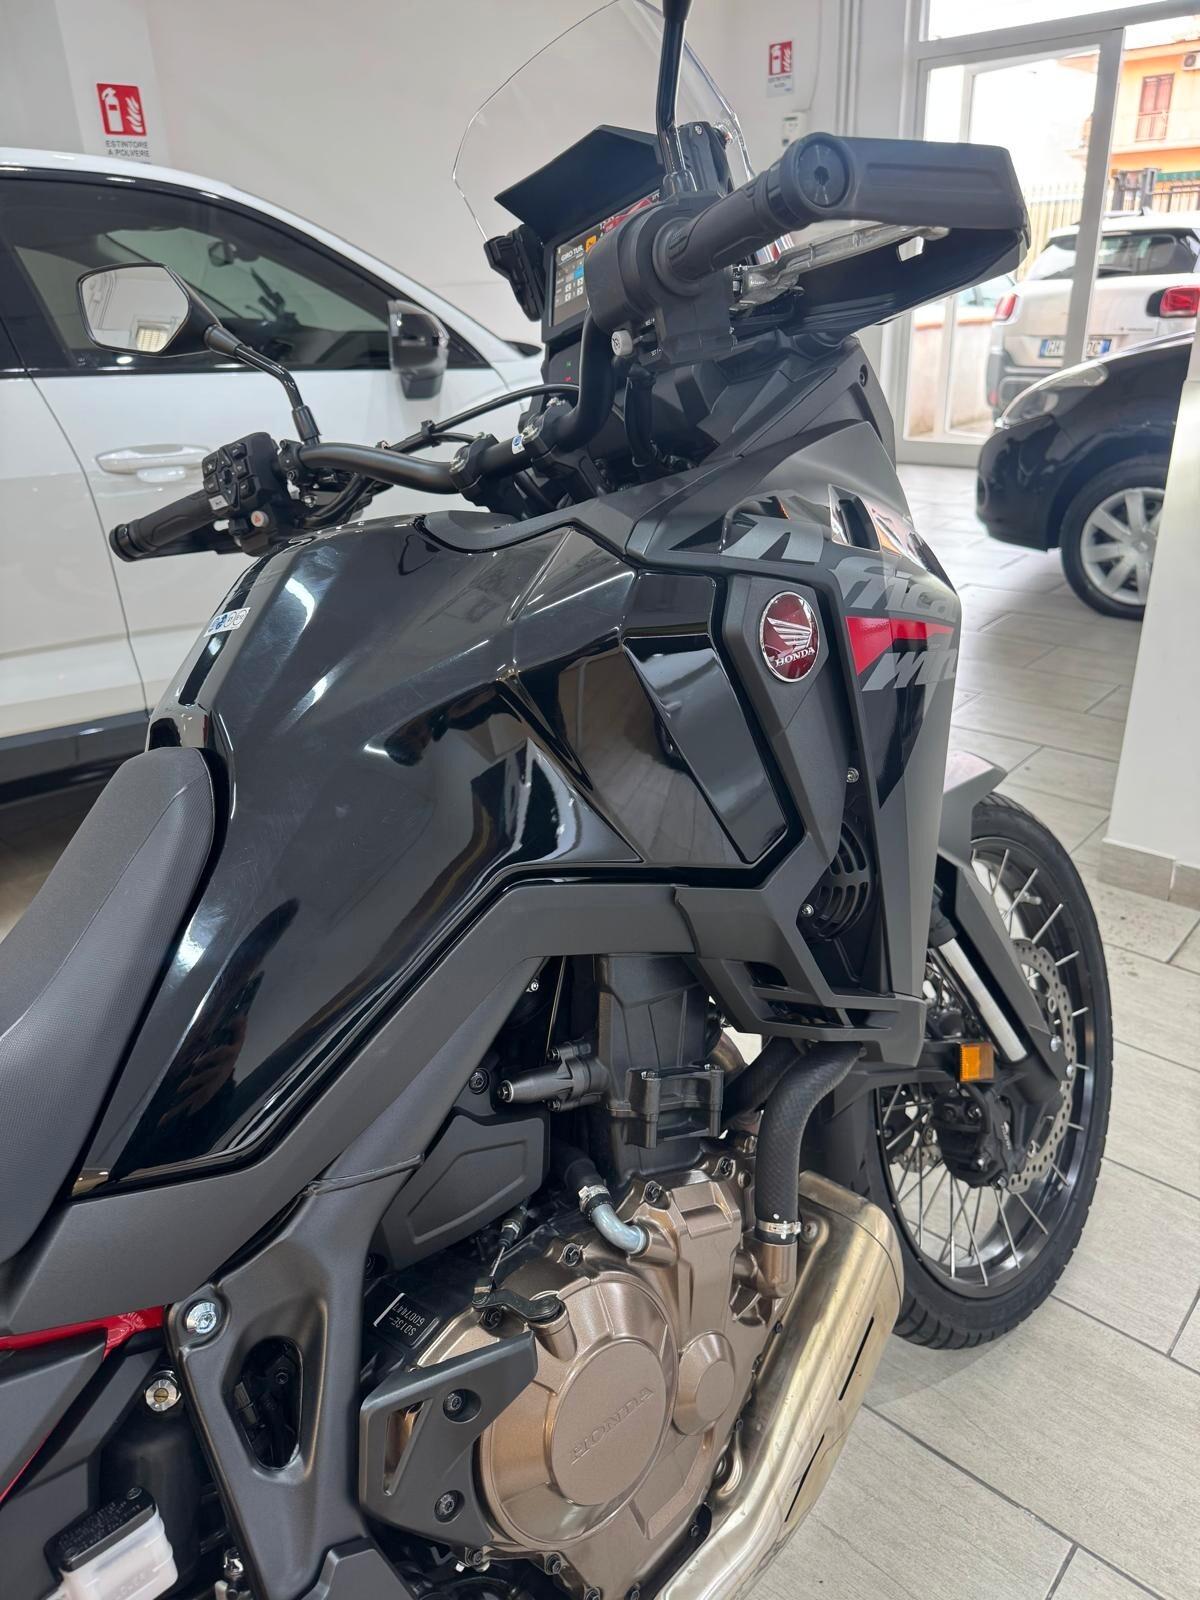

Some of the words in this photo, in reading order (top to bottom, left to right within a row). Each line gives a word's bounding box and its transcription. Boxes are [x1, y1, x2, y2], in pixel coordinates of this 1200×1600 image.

[105, 140, 149, 149] ESTINTORE
[114, 149, 150, 158] POLVERE
[775, 648, 816, 668] HONDA
[569, 1387, 654, 1464] HONDA
